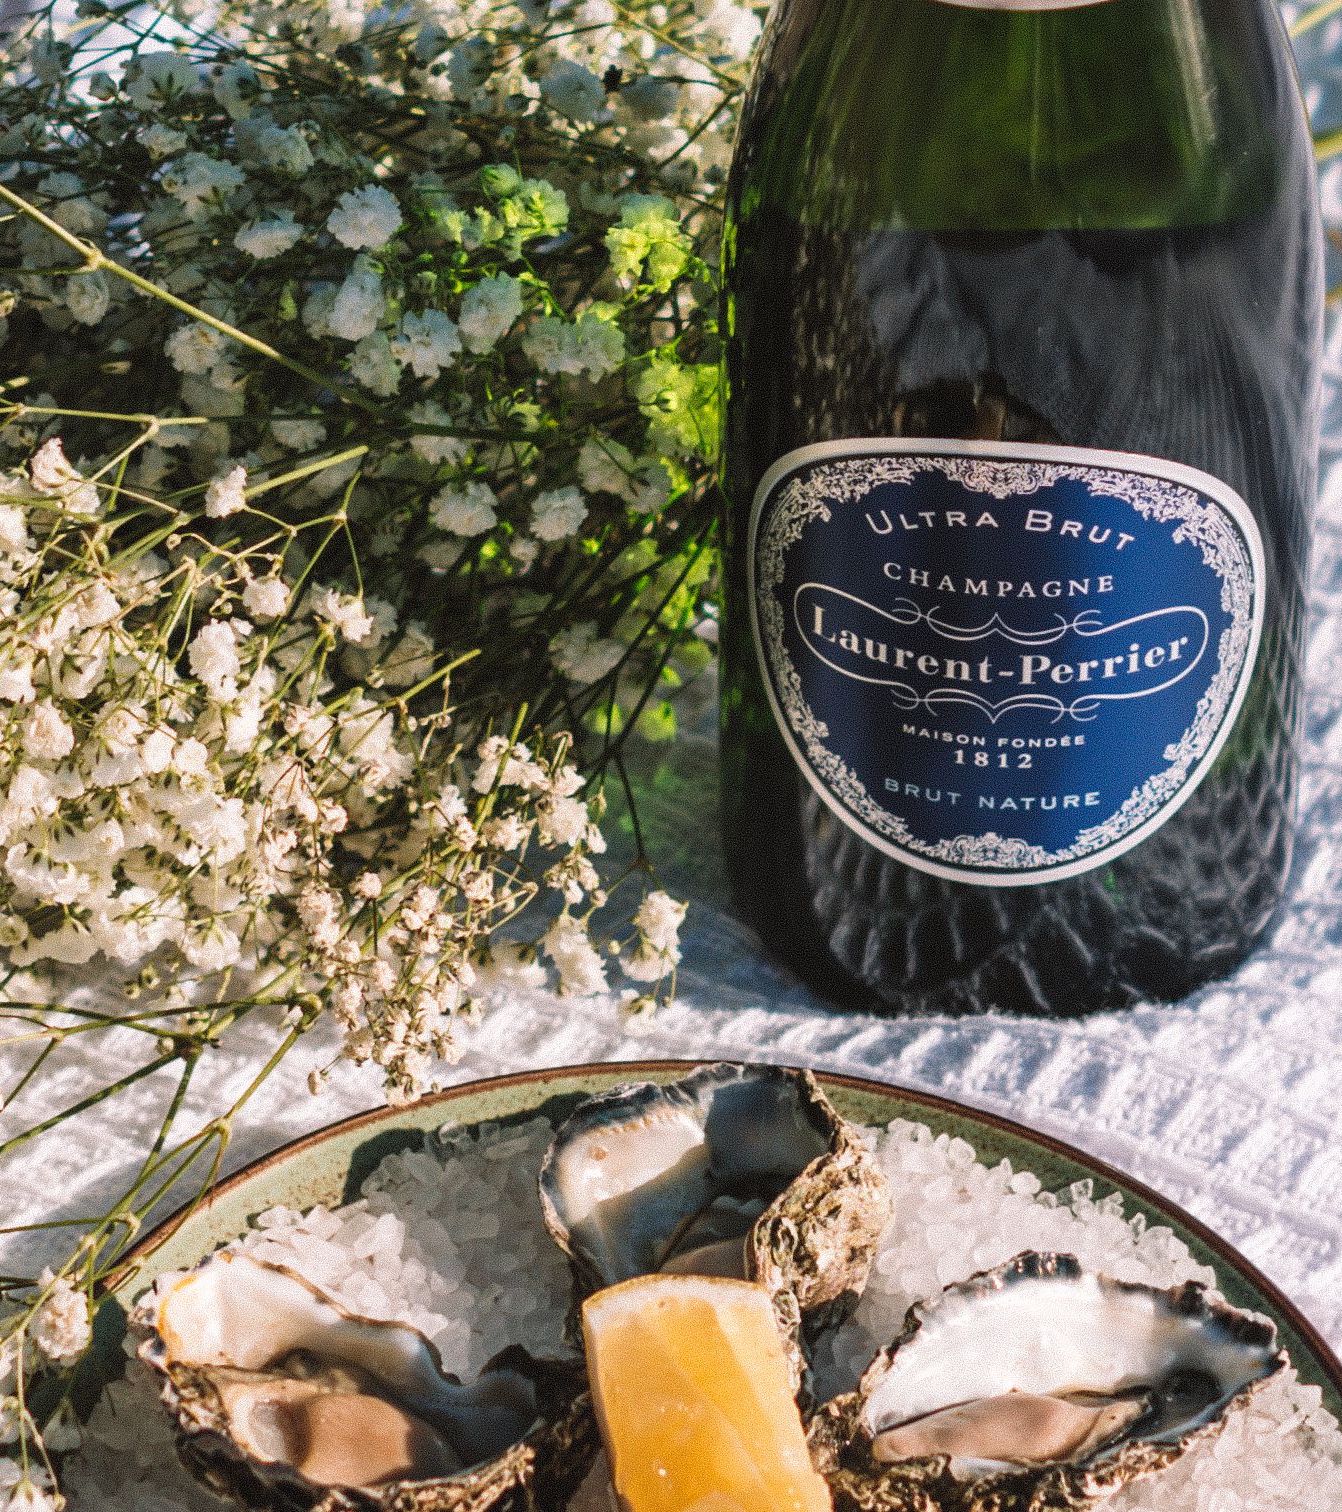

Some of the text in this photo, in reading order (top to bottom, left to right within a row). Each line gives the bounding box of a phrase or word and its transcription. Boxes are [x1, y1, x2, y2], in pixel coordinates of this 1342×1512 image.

[865, 508, 1136, 551] ULTRA BRUT
[882, 561, 1114, 599] CHAMPAGNE
[811, 602, 1189, 686] Laurent-Perrier
[902, 723, 1086, 749] MAISON FONDÉE
[953, 748, 1033, 770] 1812
[883, 777, 1101, 811] BRUT NATURE
